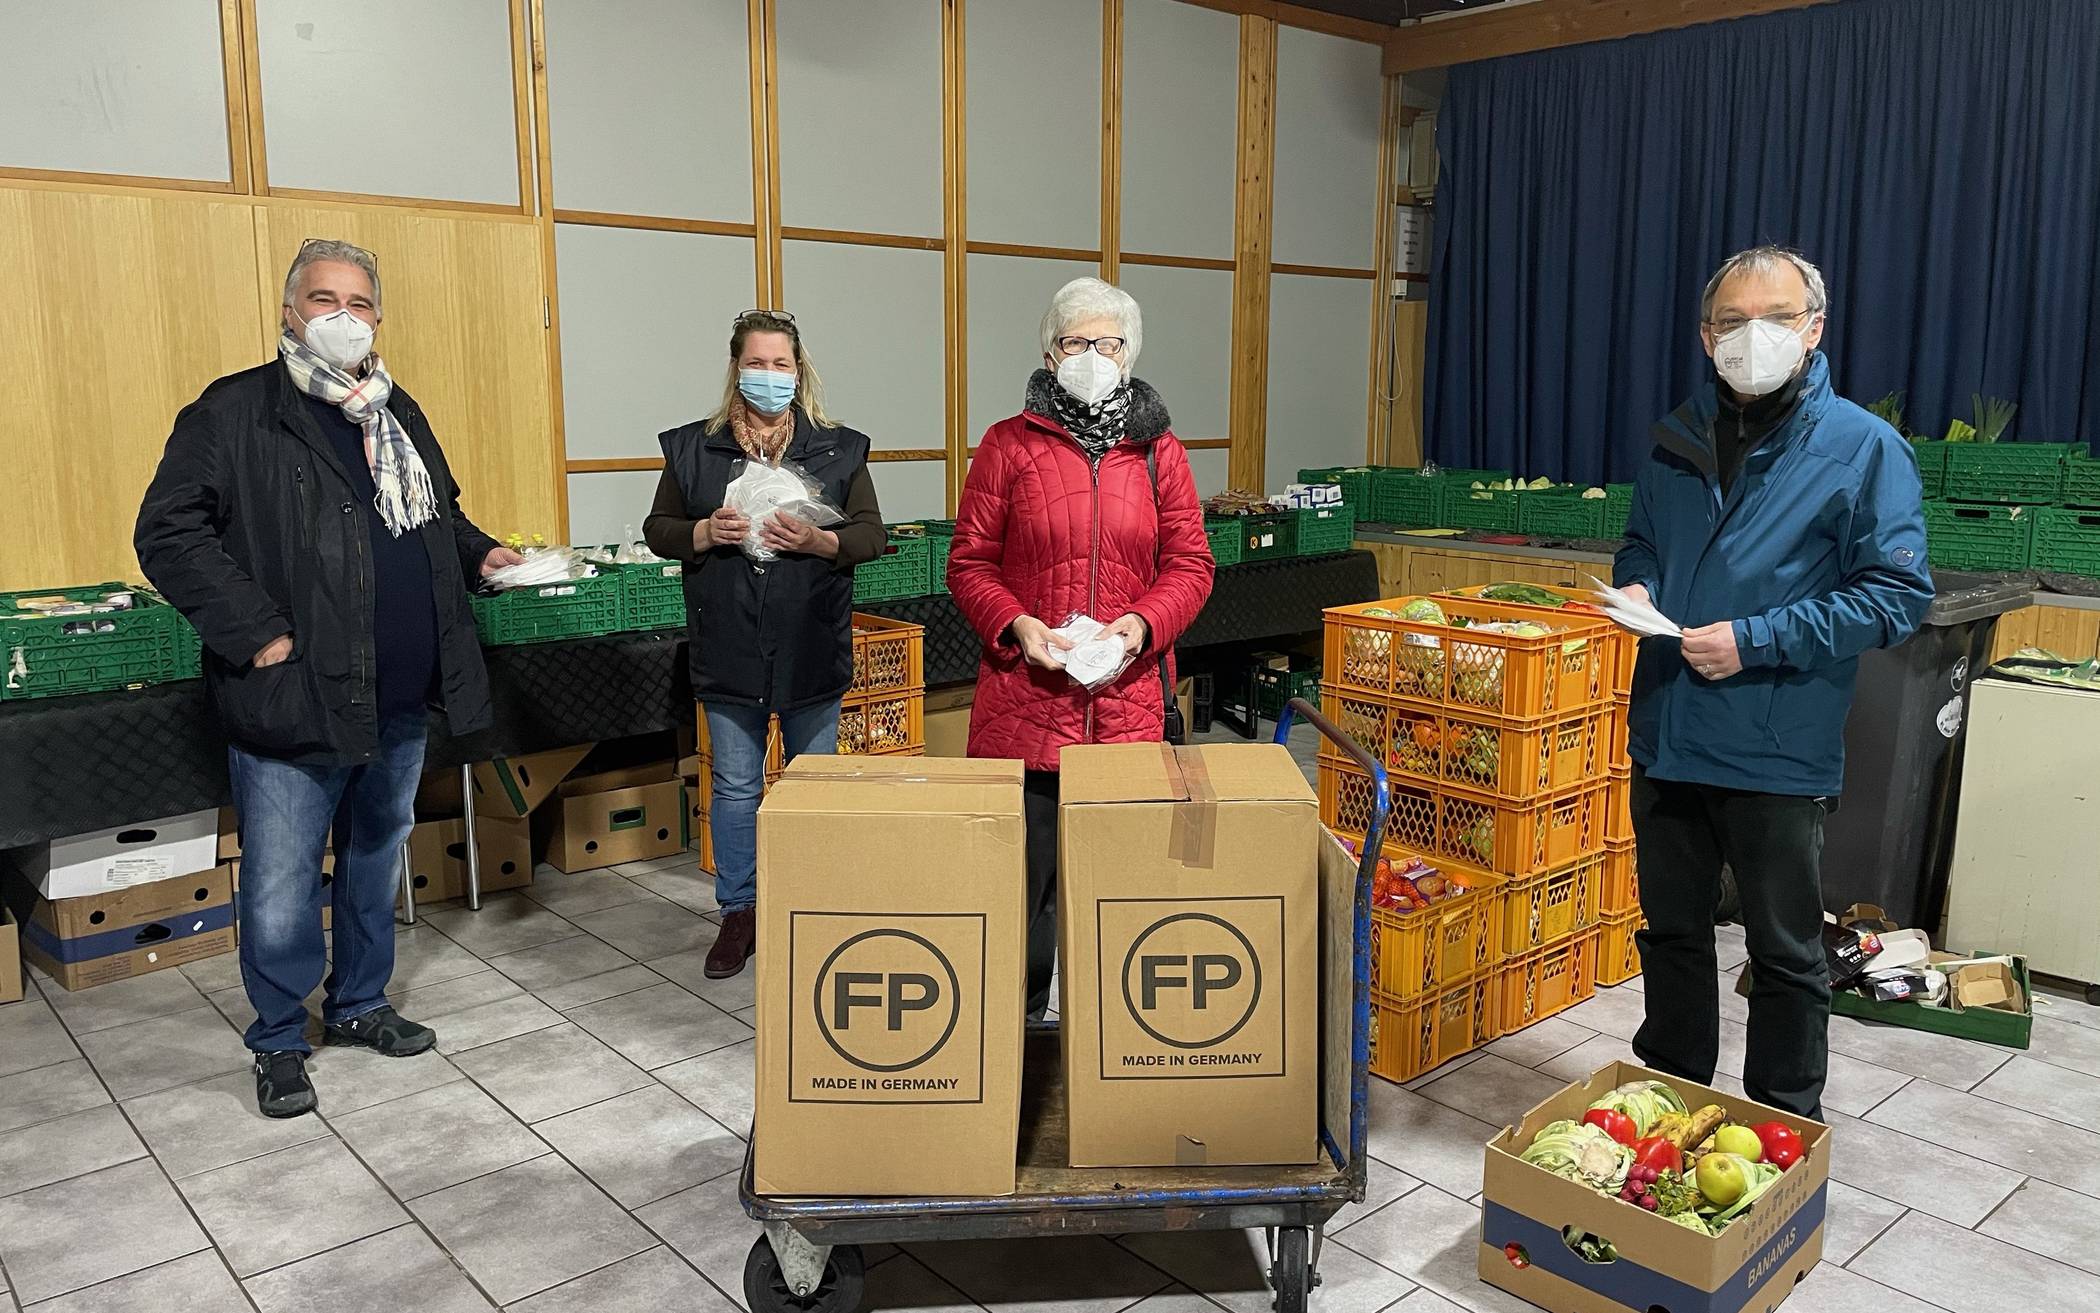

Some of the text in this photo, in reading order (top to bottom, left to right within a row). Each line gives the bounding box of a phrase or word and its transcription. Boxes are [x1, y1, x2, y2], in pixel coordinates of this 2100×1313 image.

[834, 972, 940, 1031] FP
[1141, 954, 1242, 1010] FP
[811, 1077, 960, 1091] MADE IN GERMANY
[1122, 1052, 1263, 1067] MADE IN GERMANY
[1747, 1227, 1797, 1289] BANANAS
